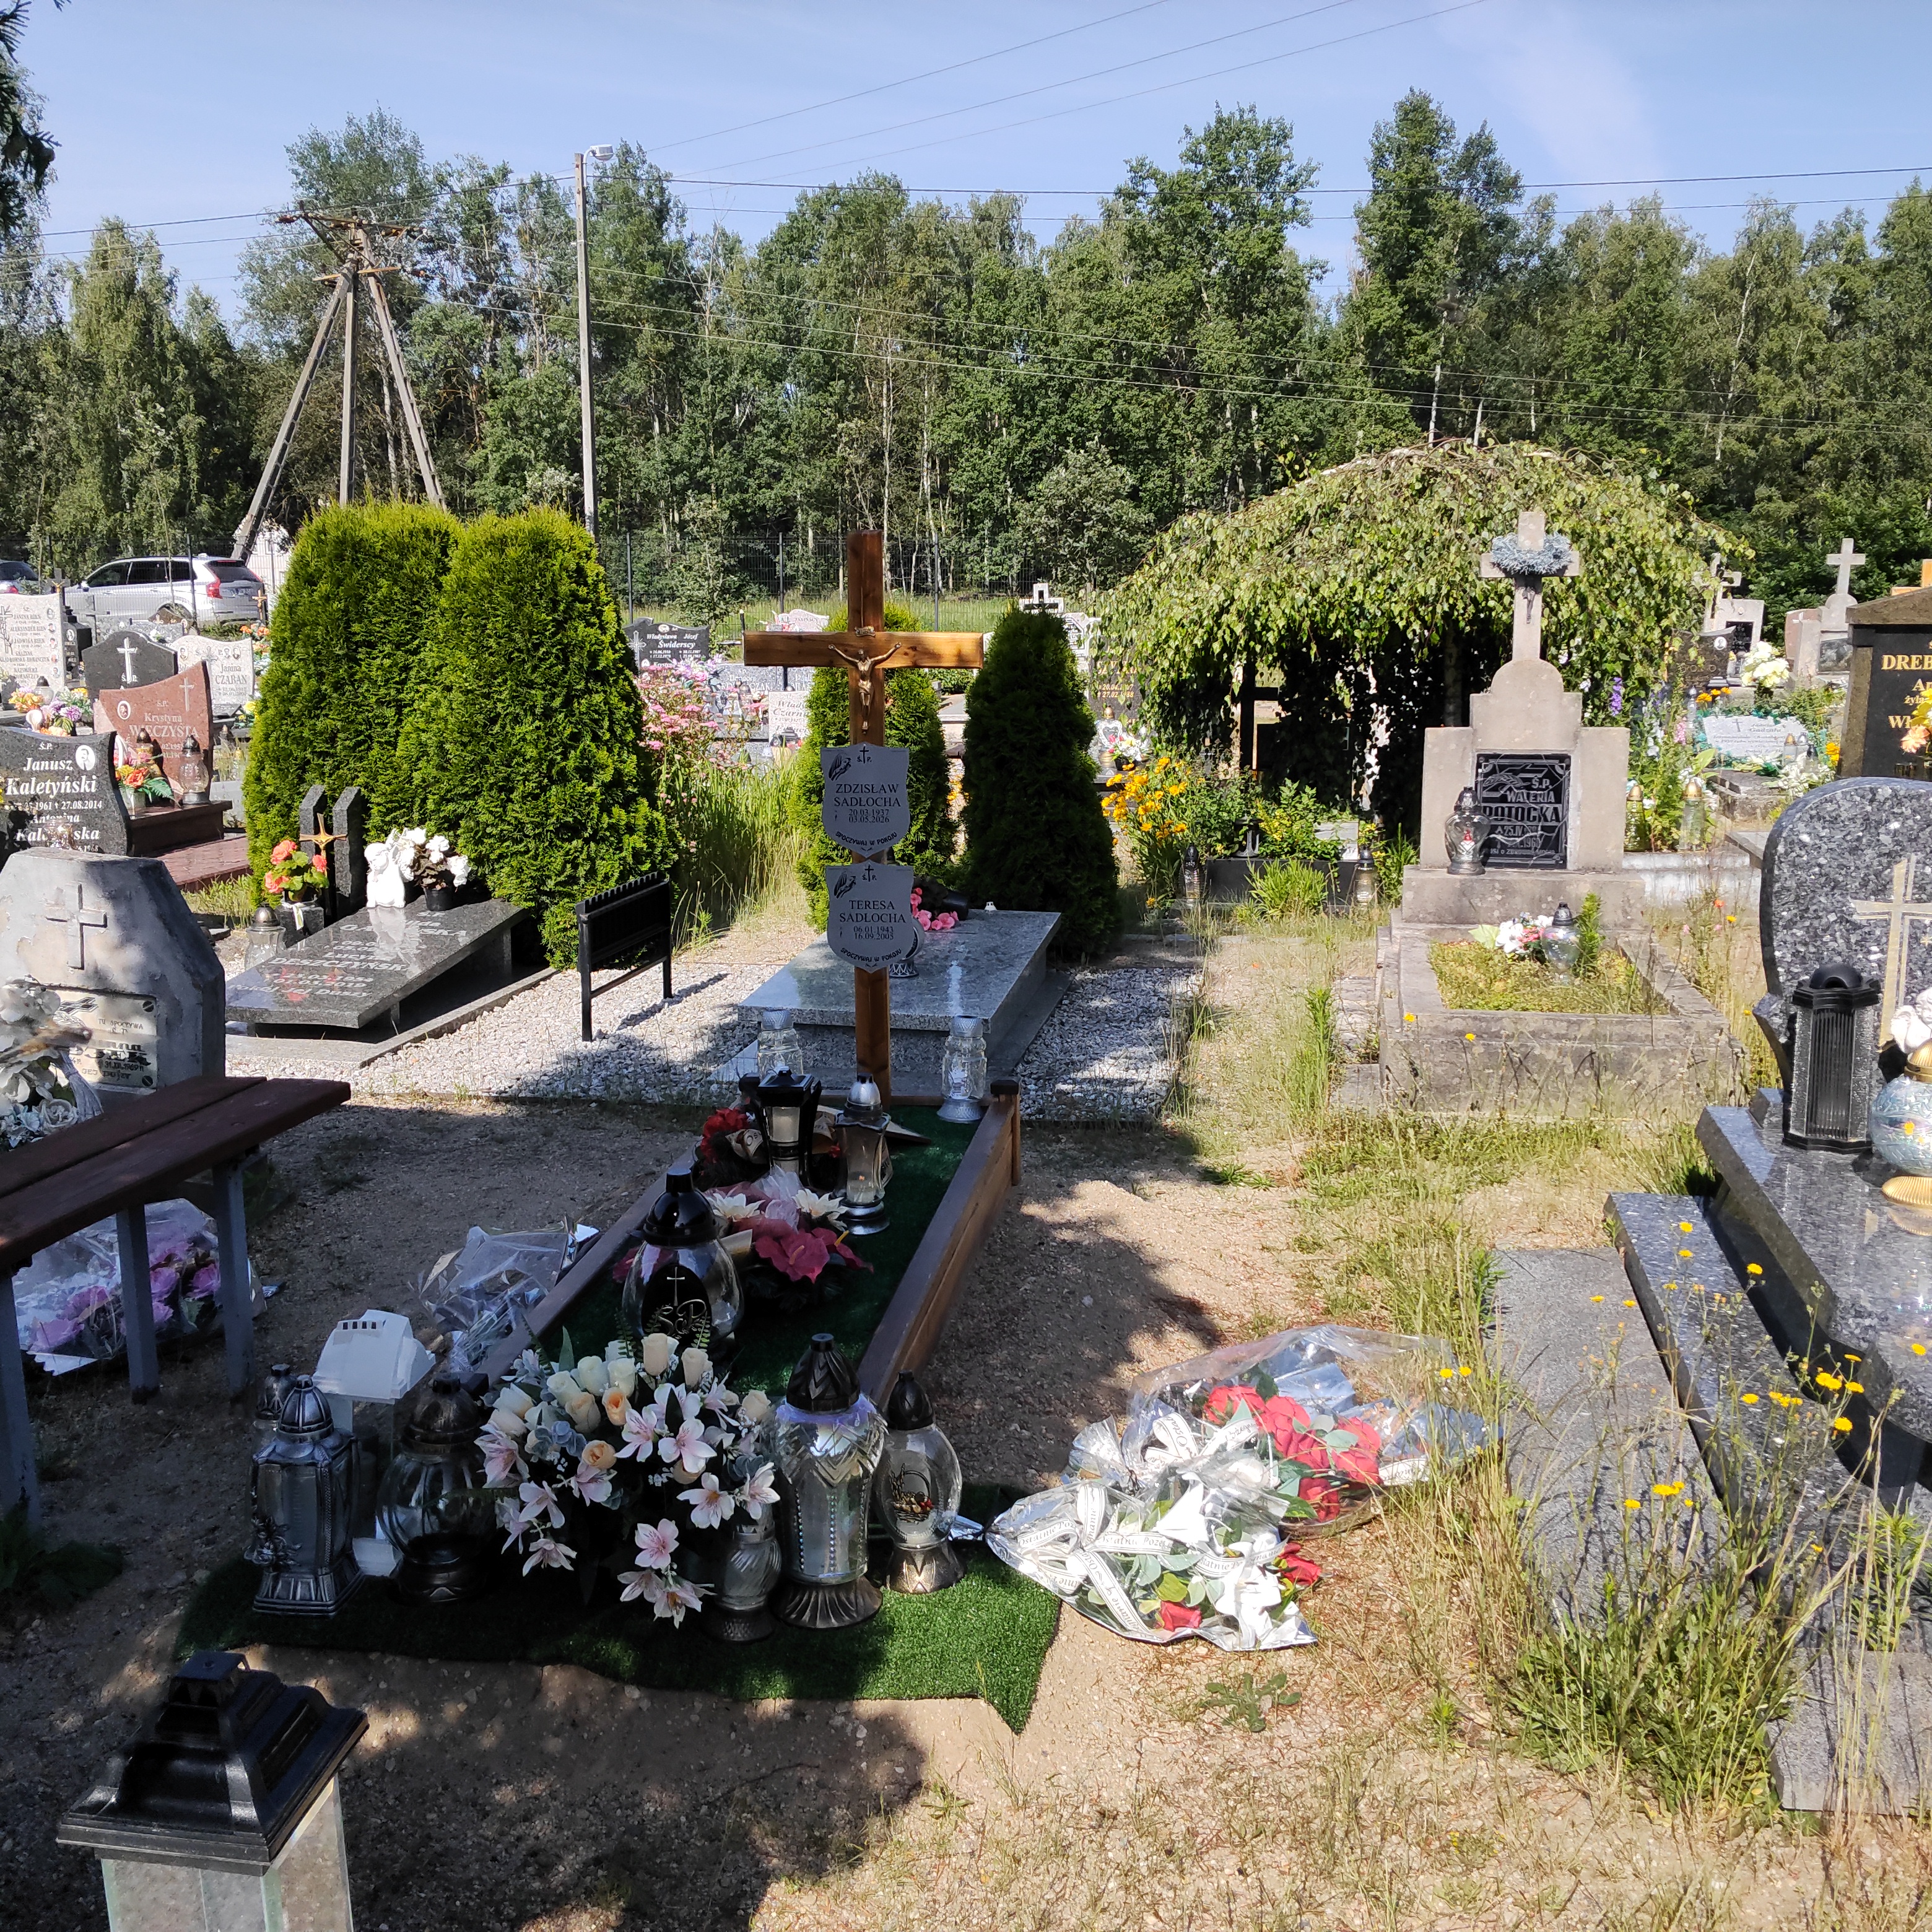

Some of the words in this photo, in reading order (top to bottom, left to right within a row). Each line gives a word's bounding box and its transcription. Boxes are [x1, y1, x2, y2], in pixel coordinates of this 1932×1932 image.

[657, 640, 695, 650] Świderscy
[144, 713, 183, 724] Krystyna
[23, 757, 74, 771] Janusz
[5, 775, 98, 799] Kaletyński
[835, 783, 899, 793] ZDZISŁAW
[1531, 775, 1552, 789] Ś.P.
[61, 800, 103, 810] 27.08.2014
[1482, 806, 1560, 823] POTOCKA
[835, 831, 867, 846] SPOCZYWAJ
[877, 831, 897, 845] POKOJU
[848, 900, 895, 910] TERESA
[840, 947, 872, 962] SPOCZYWAJ
[881, 948, 902, 962] POKOJU
[316, 989, 373, 998] Duszy
